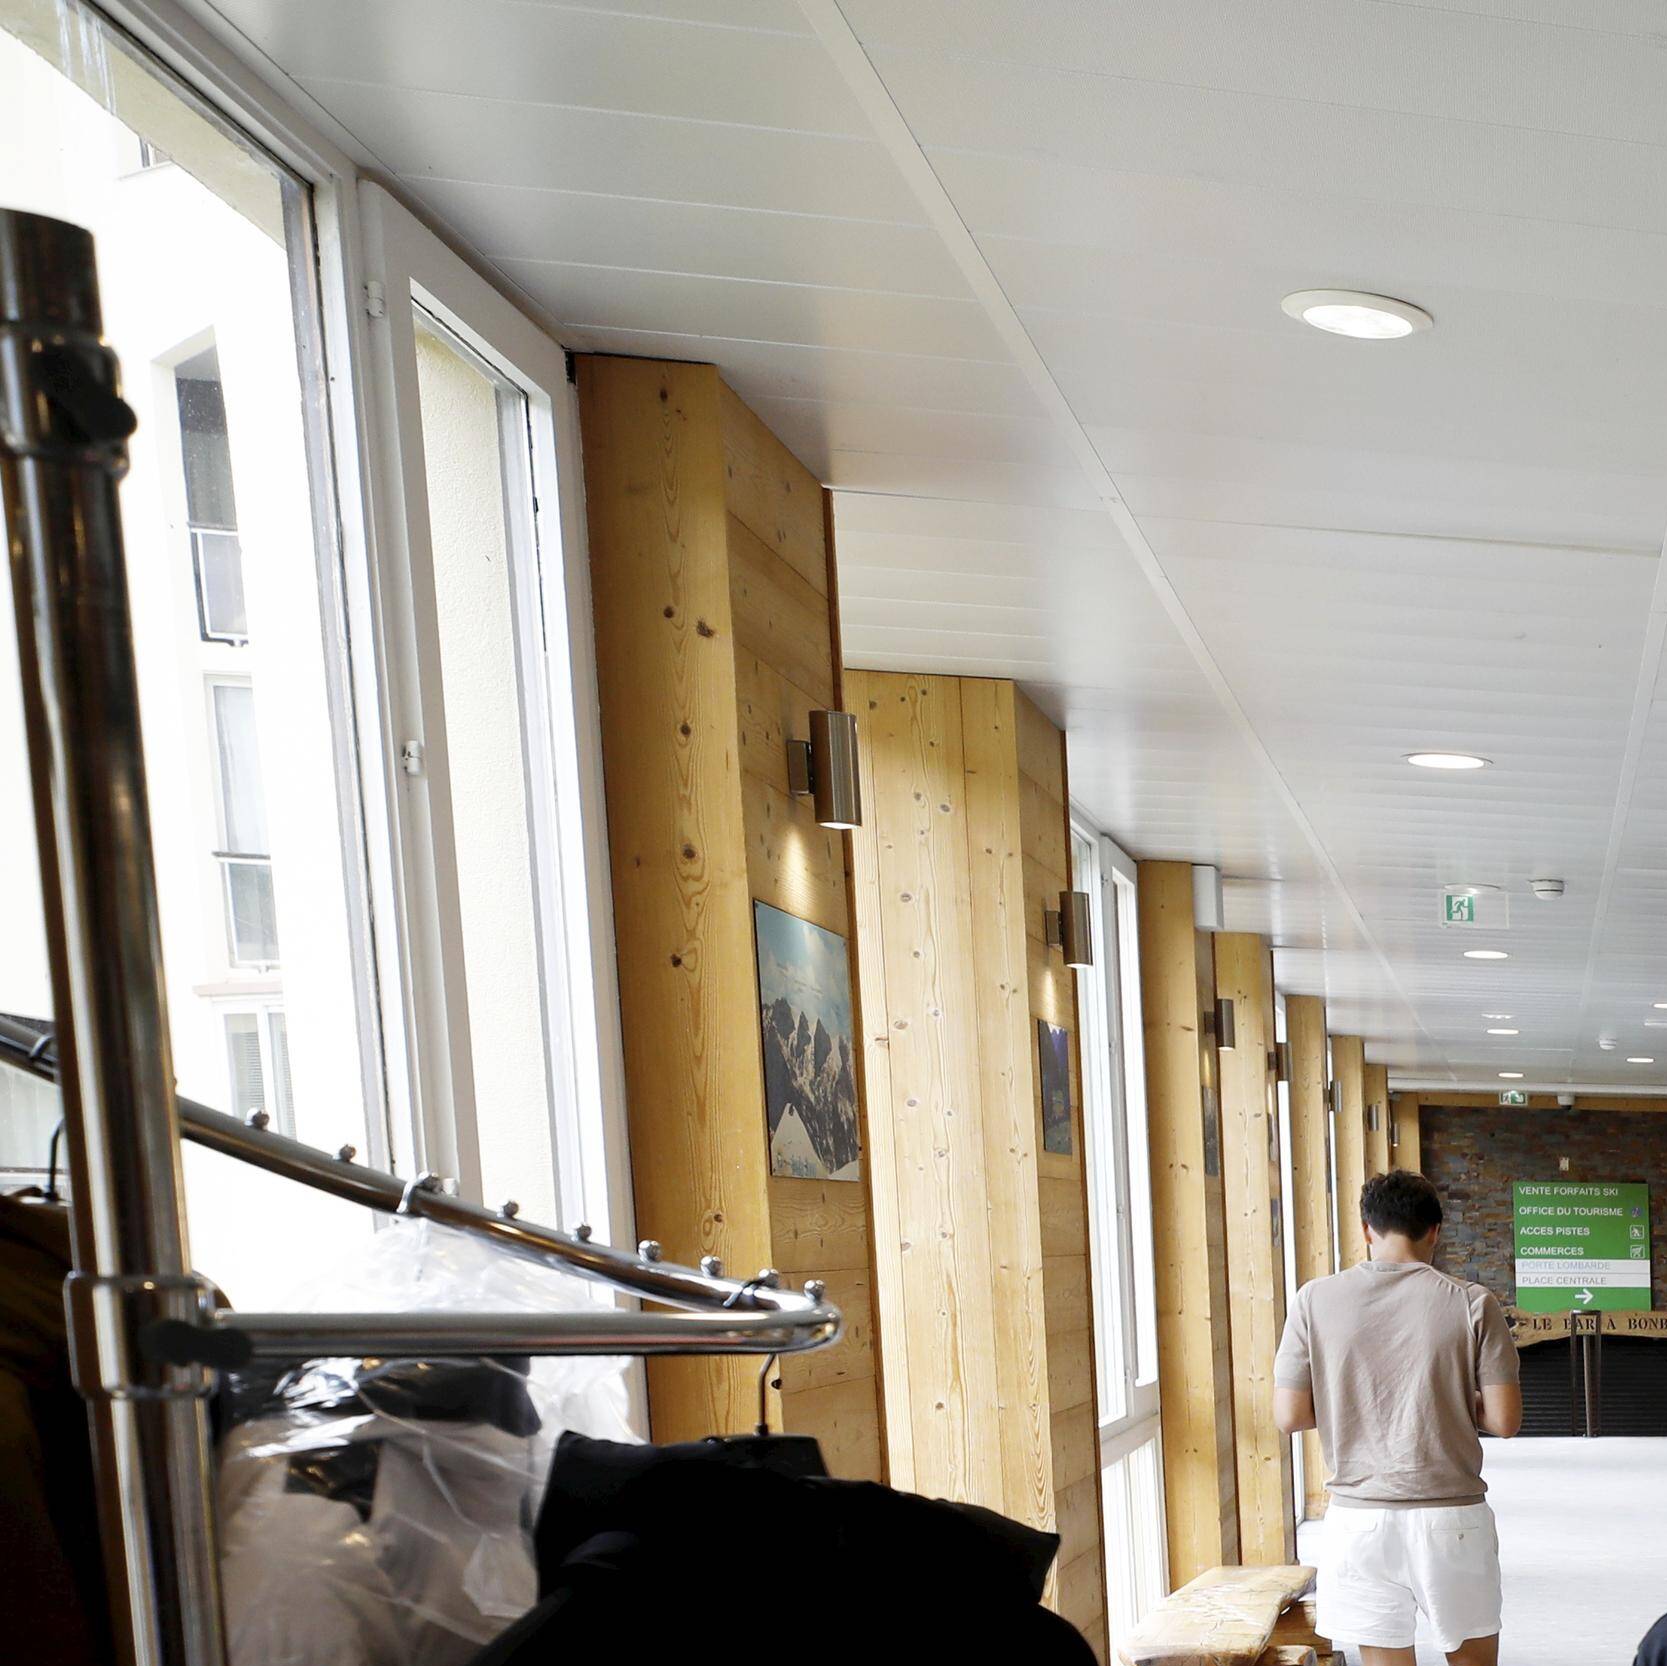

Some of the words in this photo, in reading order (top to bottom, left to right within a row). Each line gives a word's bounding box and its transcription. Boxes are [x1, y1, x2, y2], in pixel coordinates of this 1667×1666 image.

[1519, 1187, 1551, 1196] VENTE
[1554, 1187, 1601, 1196] FORFAITS
[1602, 1188, 1619, 1196] SKI
[1519, 1206, 1554, 1216] OFFICE
[1556, 1207, 1571, 1216] DU
[1574, 1207, 1624, 1217] TOURISME
[1520, 1226, 1554, 1236] ACCES
[1555, 1227, 1590, 1236] PISTES
[1520, 1247, 1584, 1256] COMMERCES
[1521, 1260, 1554, 1270] PORTE
[1557, 1261, 1611, 1271] LOMBARDE
[1522, 1276, 1553, 1285] PLACE
[1556, 1277, 1607, 1285] CENTRALE
[1533, 1319, 1552, 1331] LE
